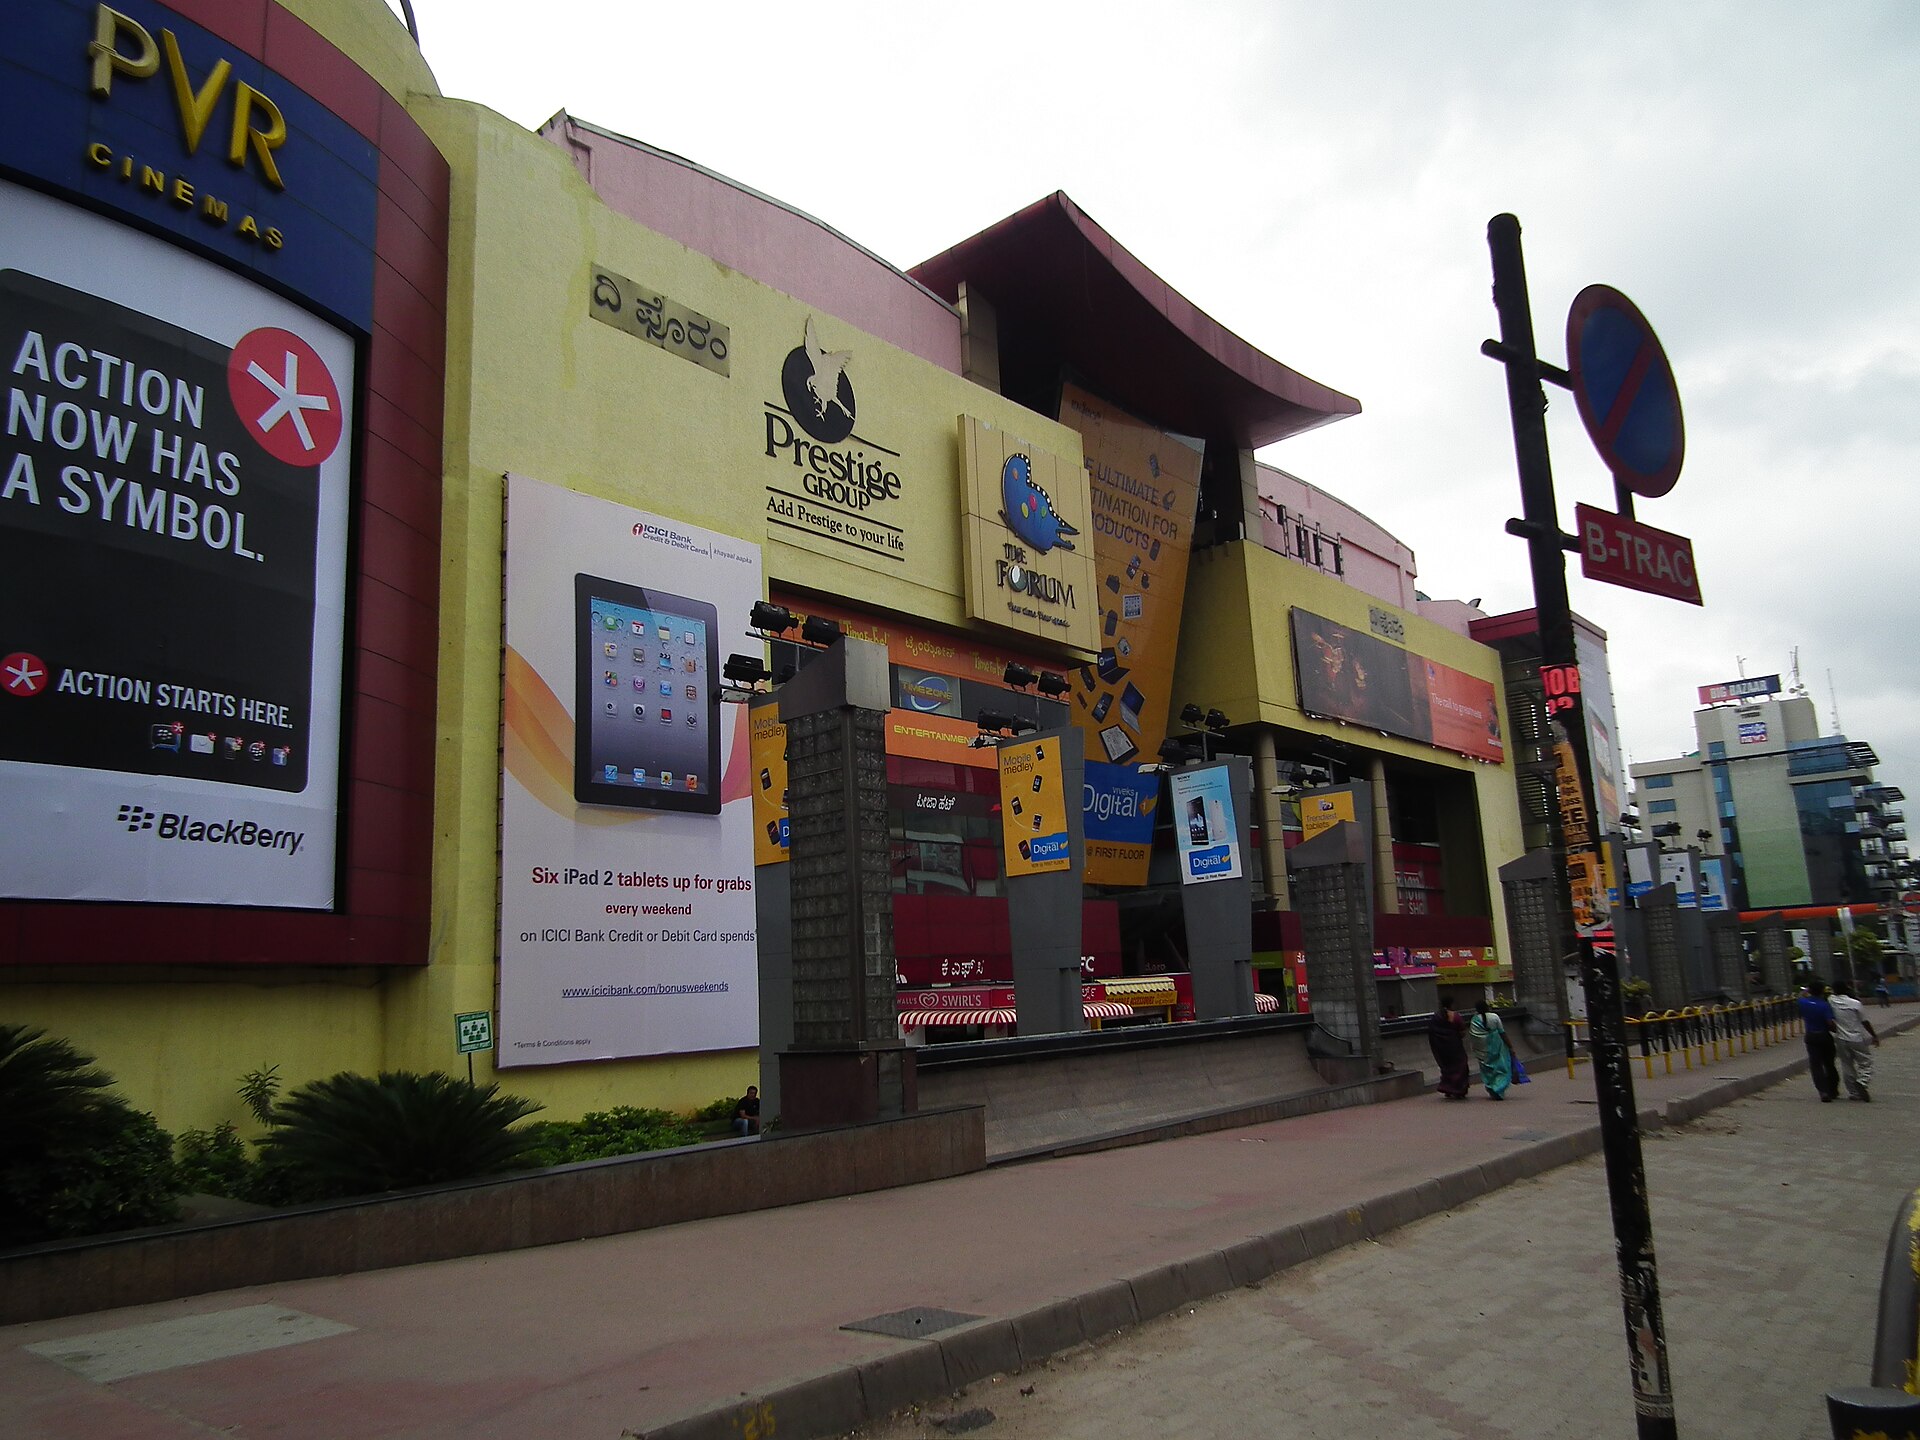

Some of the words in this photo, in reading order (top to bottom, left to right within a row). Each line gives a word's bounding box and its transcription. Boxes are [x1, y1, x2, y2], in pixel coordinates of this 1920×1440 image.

[89, 4, 287, 191] PVR
[89, 142, 283, 249] CINEMAS
[594, 274, 621, 312] ದಿ
[12, 330, 204, 429] ACTION
[7, 387, 137, 464] NOW
[152, 429, 241, 497] HAS
[764, 411, 901, 501] Prestige
[803, 473, 870, 510] GROUP
[1084, 456, 1094, 470] E
[1097, 462, 1159, 506] ULTIMATE
[2, 453, 41, 505] A
[58, 465, 264, 562] SYMBOL.
[1092, 486, 1150, 528] TINATION
[1152, 513, 1178, 540] FOR
[644, 525, 668, 537] ICICI
[669, 531, 692, 544] Bank
[766, 496, 793, 517] Add
[797, 505, 842, 533] Prestige
[845, 523, 857, 537] to
[860, 529, 884, 545] your
[887, 532, 904, 550] life
[1092, 511, 1150, 550] ODUCTS
[642, 533, 664, 544] Credit
[671, 540, 689, 550] Debit
[690, 545, 709, 556] Cards
[1003, 543, 1027, 565] THE
[1585, 521, 1694, 588] B-TRAC
[996, 559, 1076, 610] FORUM
[57, 668, 151, 704] ACTION
[157, 683, 236, 718] STARTS
[241, 699, 293, 729] HERE.
[901, 681, 953, 700] TIMEZONE
[1710, 686, 1727, 699] BIG
[754, 714, 779, 730] Mobil
[754, 725, 786, 741] medley
[893, 724, 971, 745] ENTERTAINMEN
[1004, 753, 1032, 766] Mobile
[1004, 762, 1034, 775] medley
[1083, 783, 1139, 820] Digital
[158, 812, 304, 856] BlackBerry
[1033, 841, 1059, 855] Digital
[1095, 846, 1117, 858] FIRST
[1119, 848, 1145, 860] FLOOR
[1193, 854, 1221, 868] Digital
[532, 867, 559, 884] Six
[564, 868, 599, 886] iPad
[603, 870, 614, 886] 2
[617, 871, 669, 888] tablets
[673, 876, 690, 892] up
[694, 874, 713, 890] for
[717, 876, 752, 893] grabs
[605, 904, 638, 917] every
[642, 903, 692, 915] weekend
[520, 931, 537, 942] on
[541, 929, 571, 942] ICICI
[575, 929, 605, 942] Bank
[608, 929, 643, 942] Credit
[646, 931, 659, 942] or
[662, 930, 690, 942] Debit
[693, 930, 717, 942] Card
[1081, 956, 1095, 972] FC
[562, 981, 729, 998] www.icicibank.com/bonusweekends
[941, 994, 982, 1007] SWIRL'S
